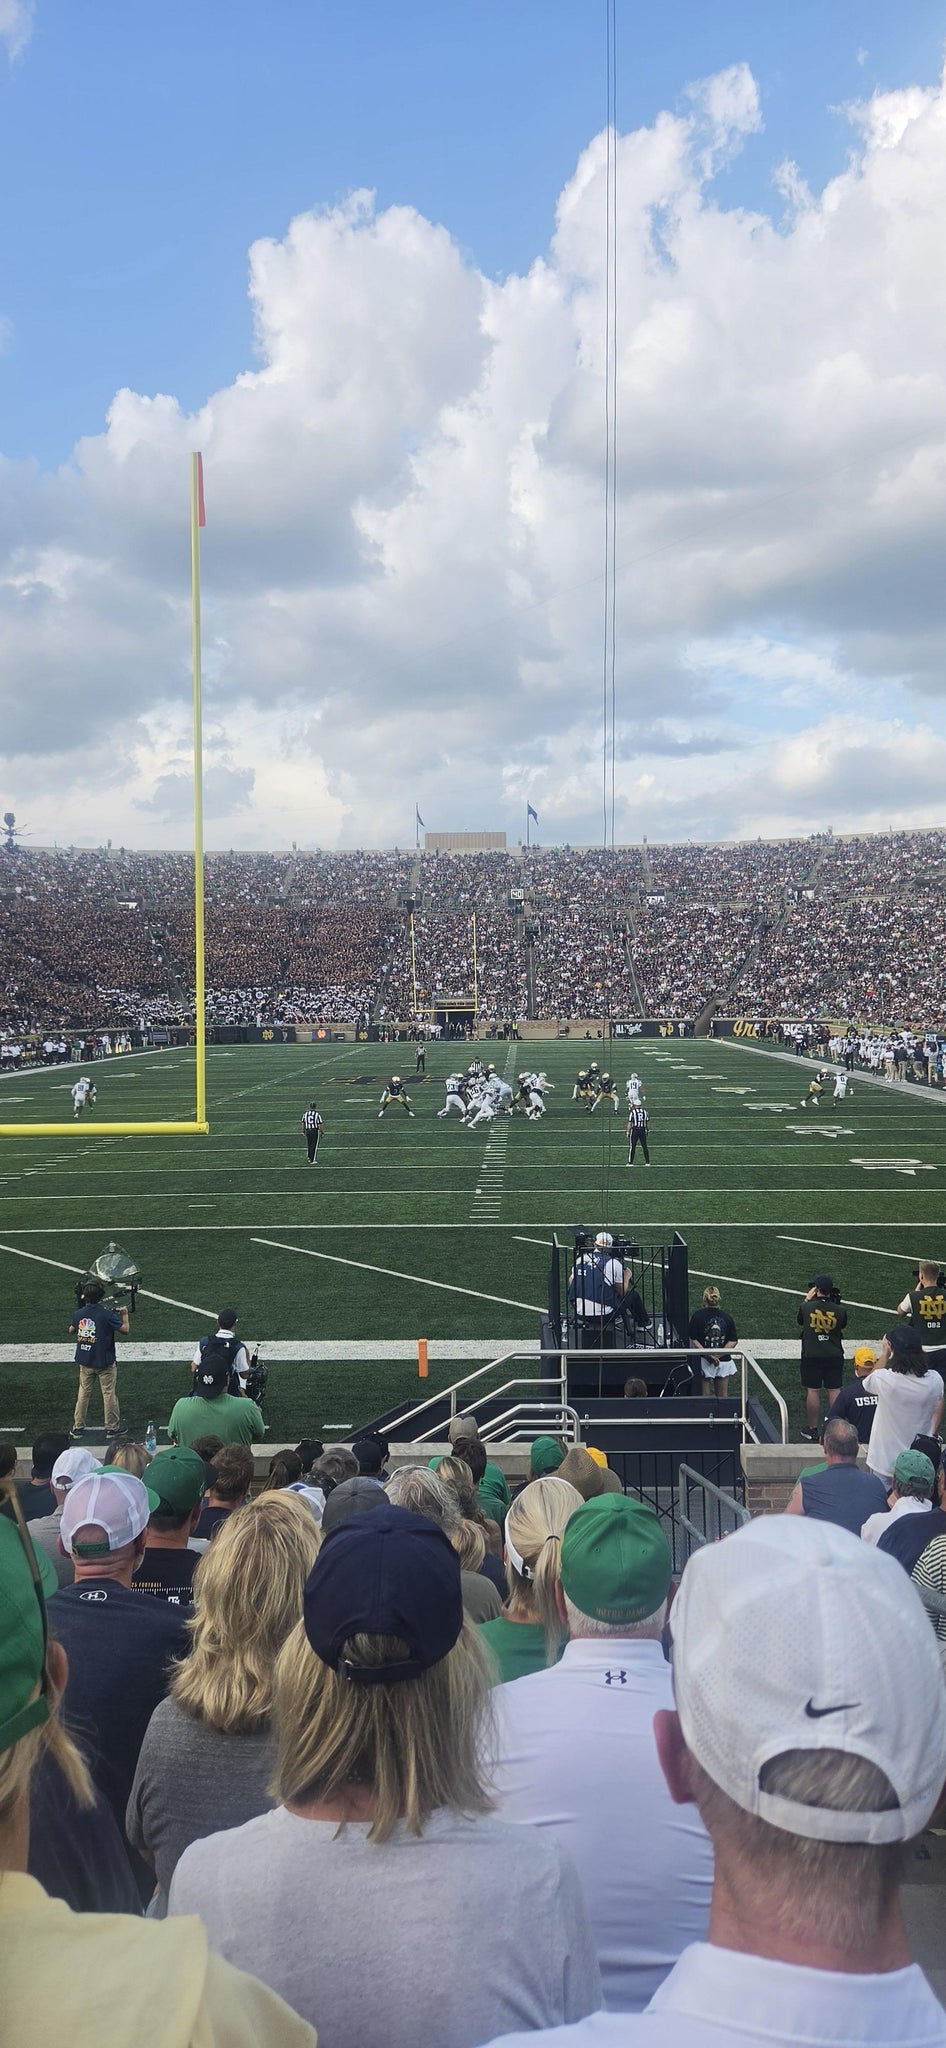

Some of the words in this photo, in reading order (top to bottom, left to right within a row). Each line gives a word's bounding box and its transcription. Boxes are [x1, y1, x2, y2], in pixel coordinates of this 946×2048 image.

[307, 1115, 314, 1124] C
[637, 1112, 644, 1121] R
[78, 1329, 96, 1338] NBC
[855, 1396, 879, 1407] USH
